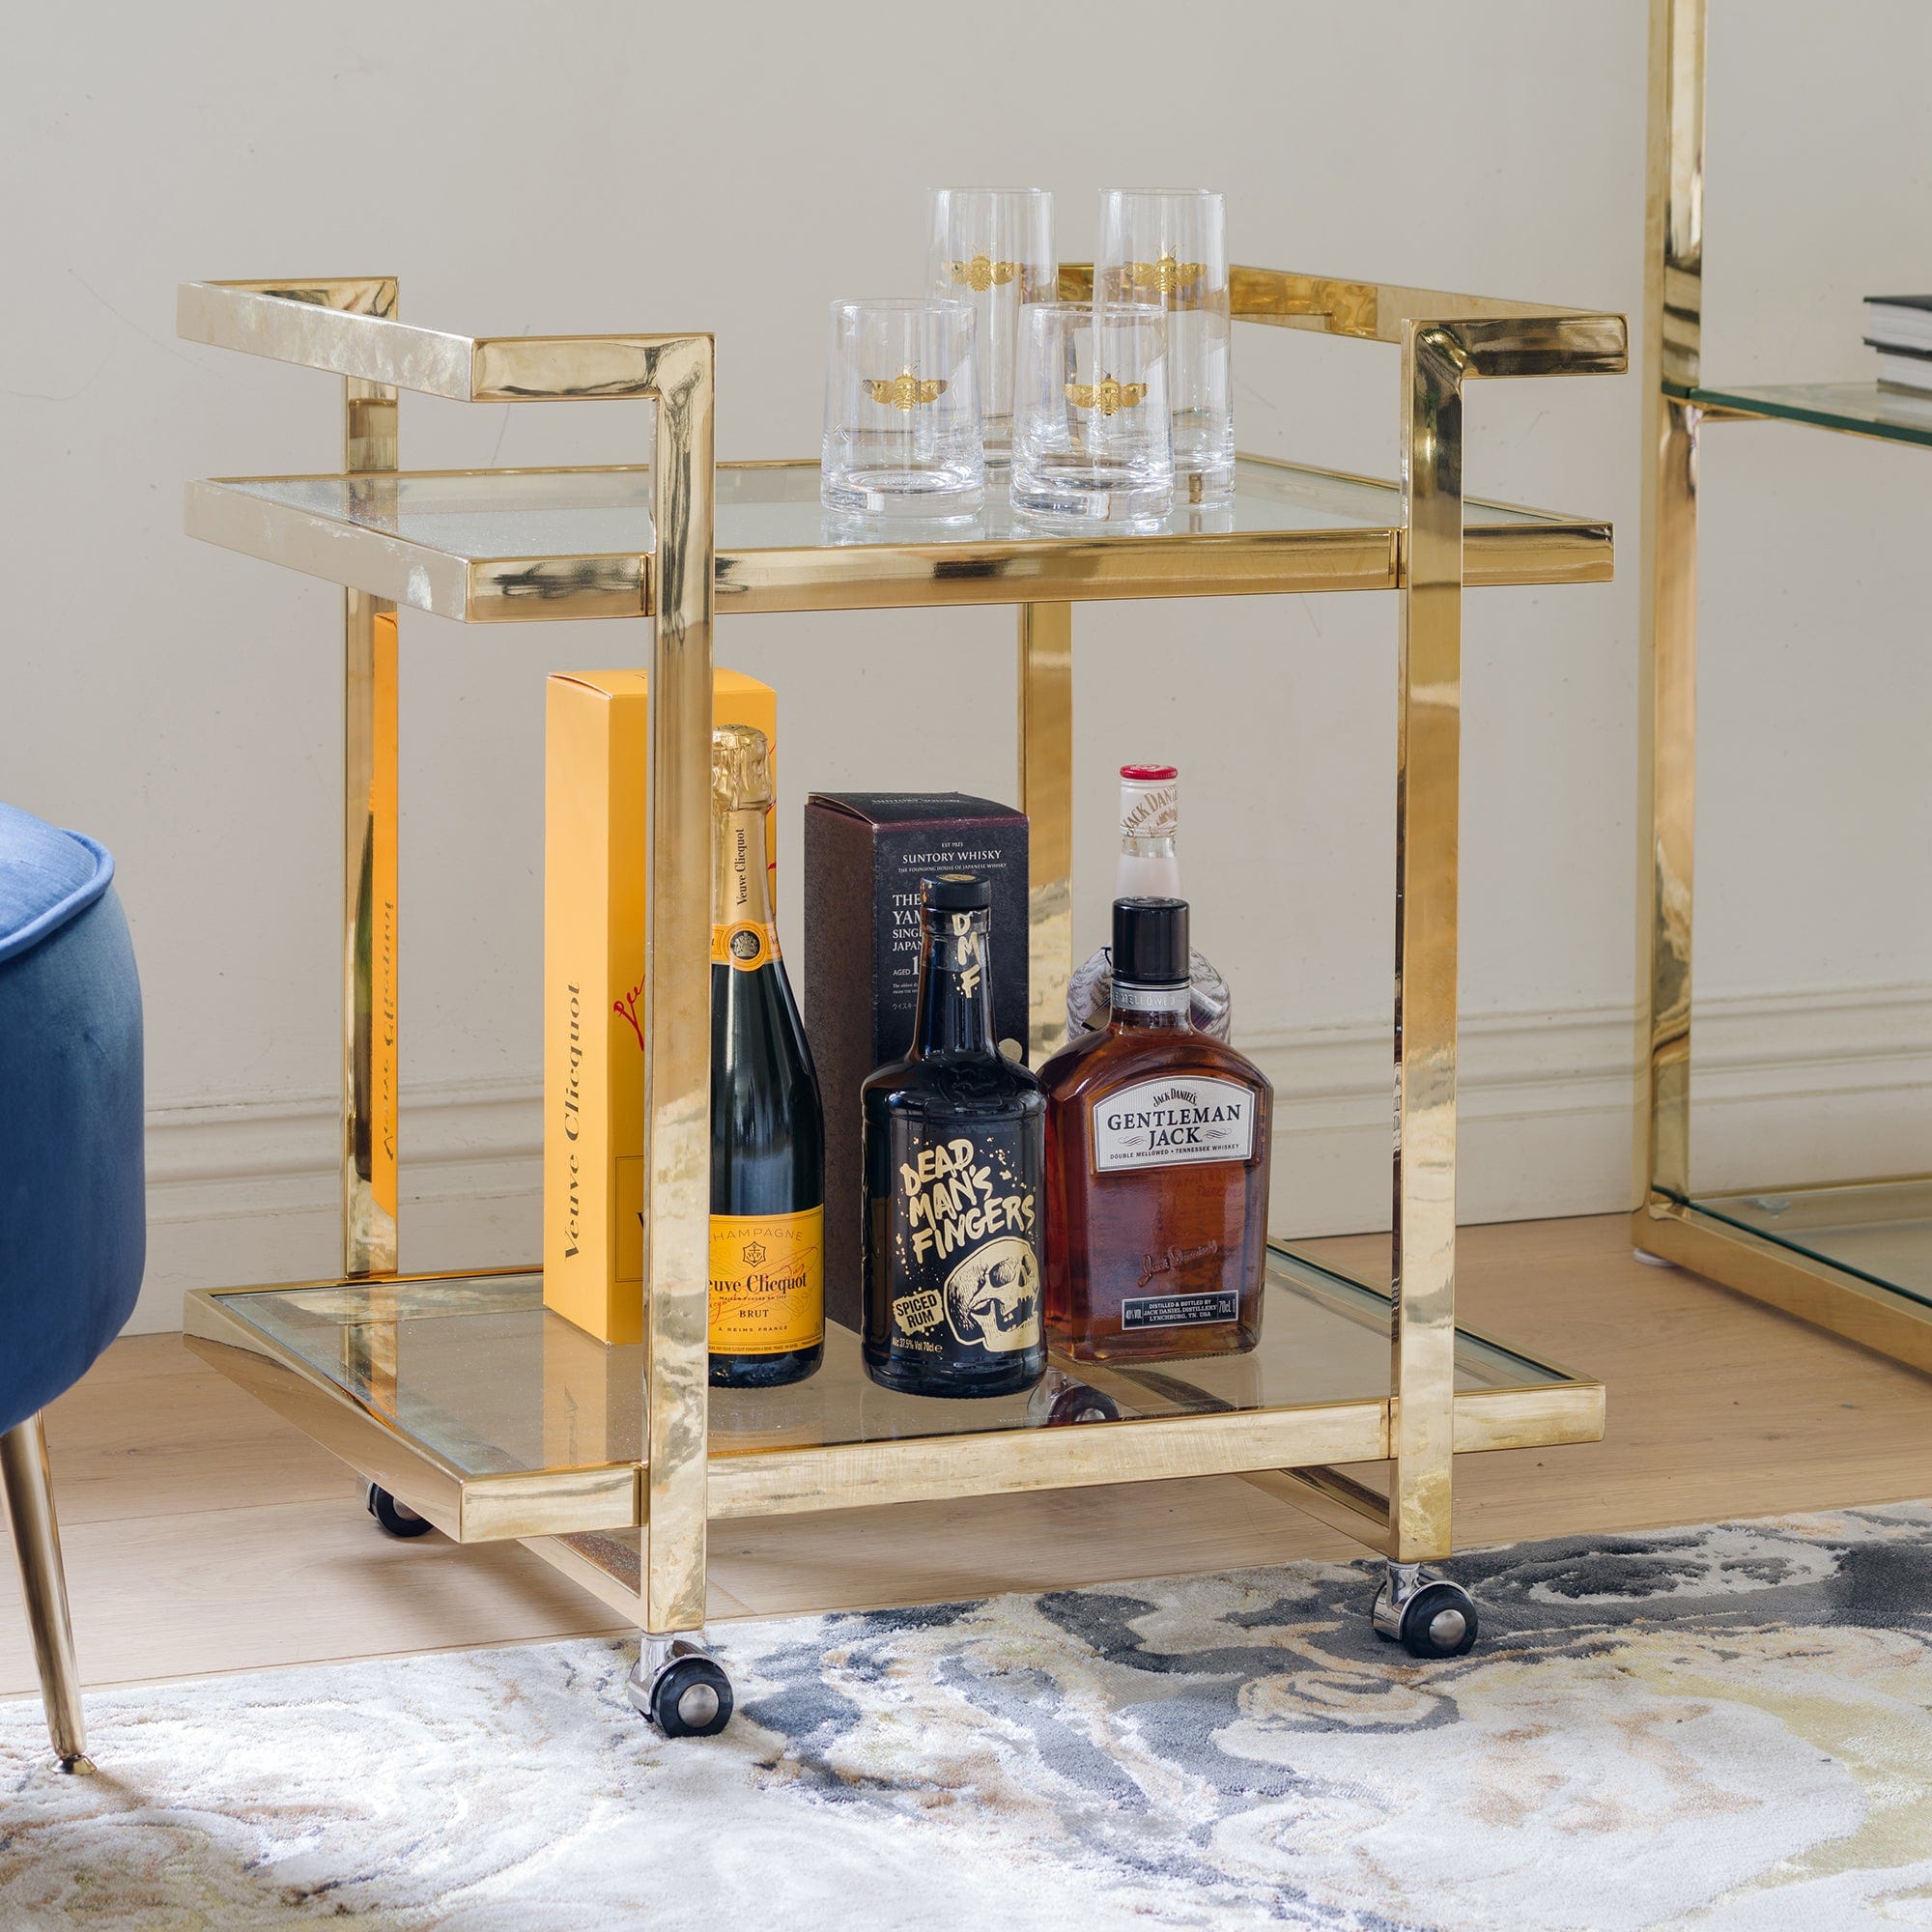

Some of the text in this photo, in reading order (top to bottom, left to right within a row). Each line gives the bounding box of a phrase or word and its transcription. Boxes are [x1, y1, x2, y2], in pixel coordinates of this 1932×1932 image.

[734, 828, 748, 906] Veuve Clicquot
[902, 850, 1002, 864] SUNTORY WHISKY
[1153, 1092, 1171, 1107] JACK
[564, 981, 582, 1261] Veuve Clicquot
[1107, 1105, 1241, 1130] GENTLEMAN
[900, 1138, 974, 1197] DEAD
[908, 1165, 993, 1231] MAN'S
[709, 1228, 804, 1243] HAMPAGNE
[912, 1195, 1036, 1264] FINGERS
[746, 1272, 808, 1294] Clicquot
[895, 1294, 937, 1317] SPICED
[906, 1309, 935, 1329] RUM
